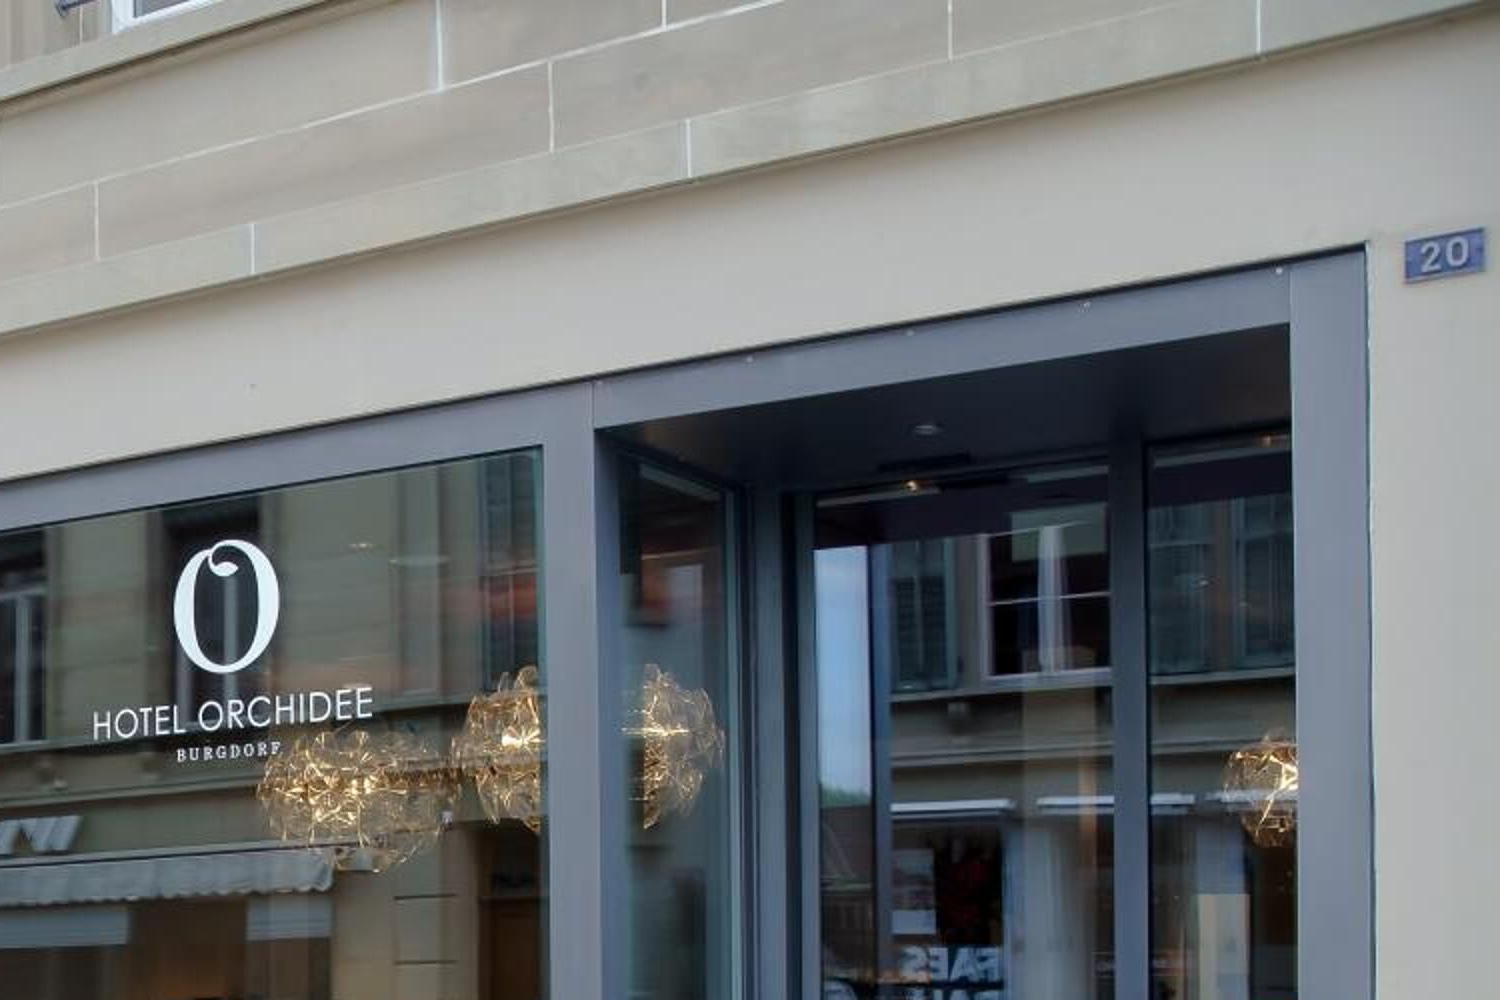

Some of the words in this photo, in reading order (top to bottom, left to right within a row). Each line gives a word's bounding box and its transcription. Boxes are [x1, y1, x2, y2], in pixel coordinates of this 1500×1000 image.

[1421, 236, 1469, 272] 20
[93, 704, 187, 741] HOTEL
[198, 687, 373, 732] ORCHIDEE
[176, 742, 282, 763] BURGDORF
